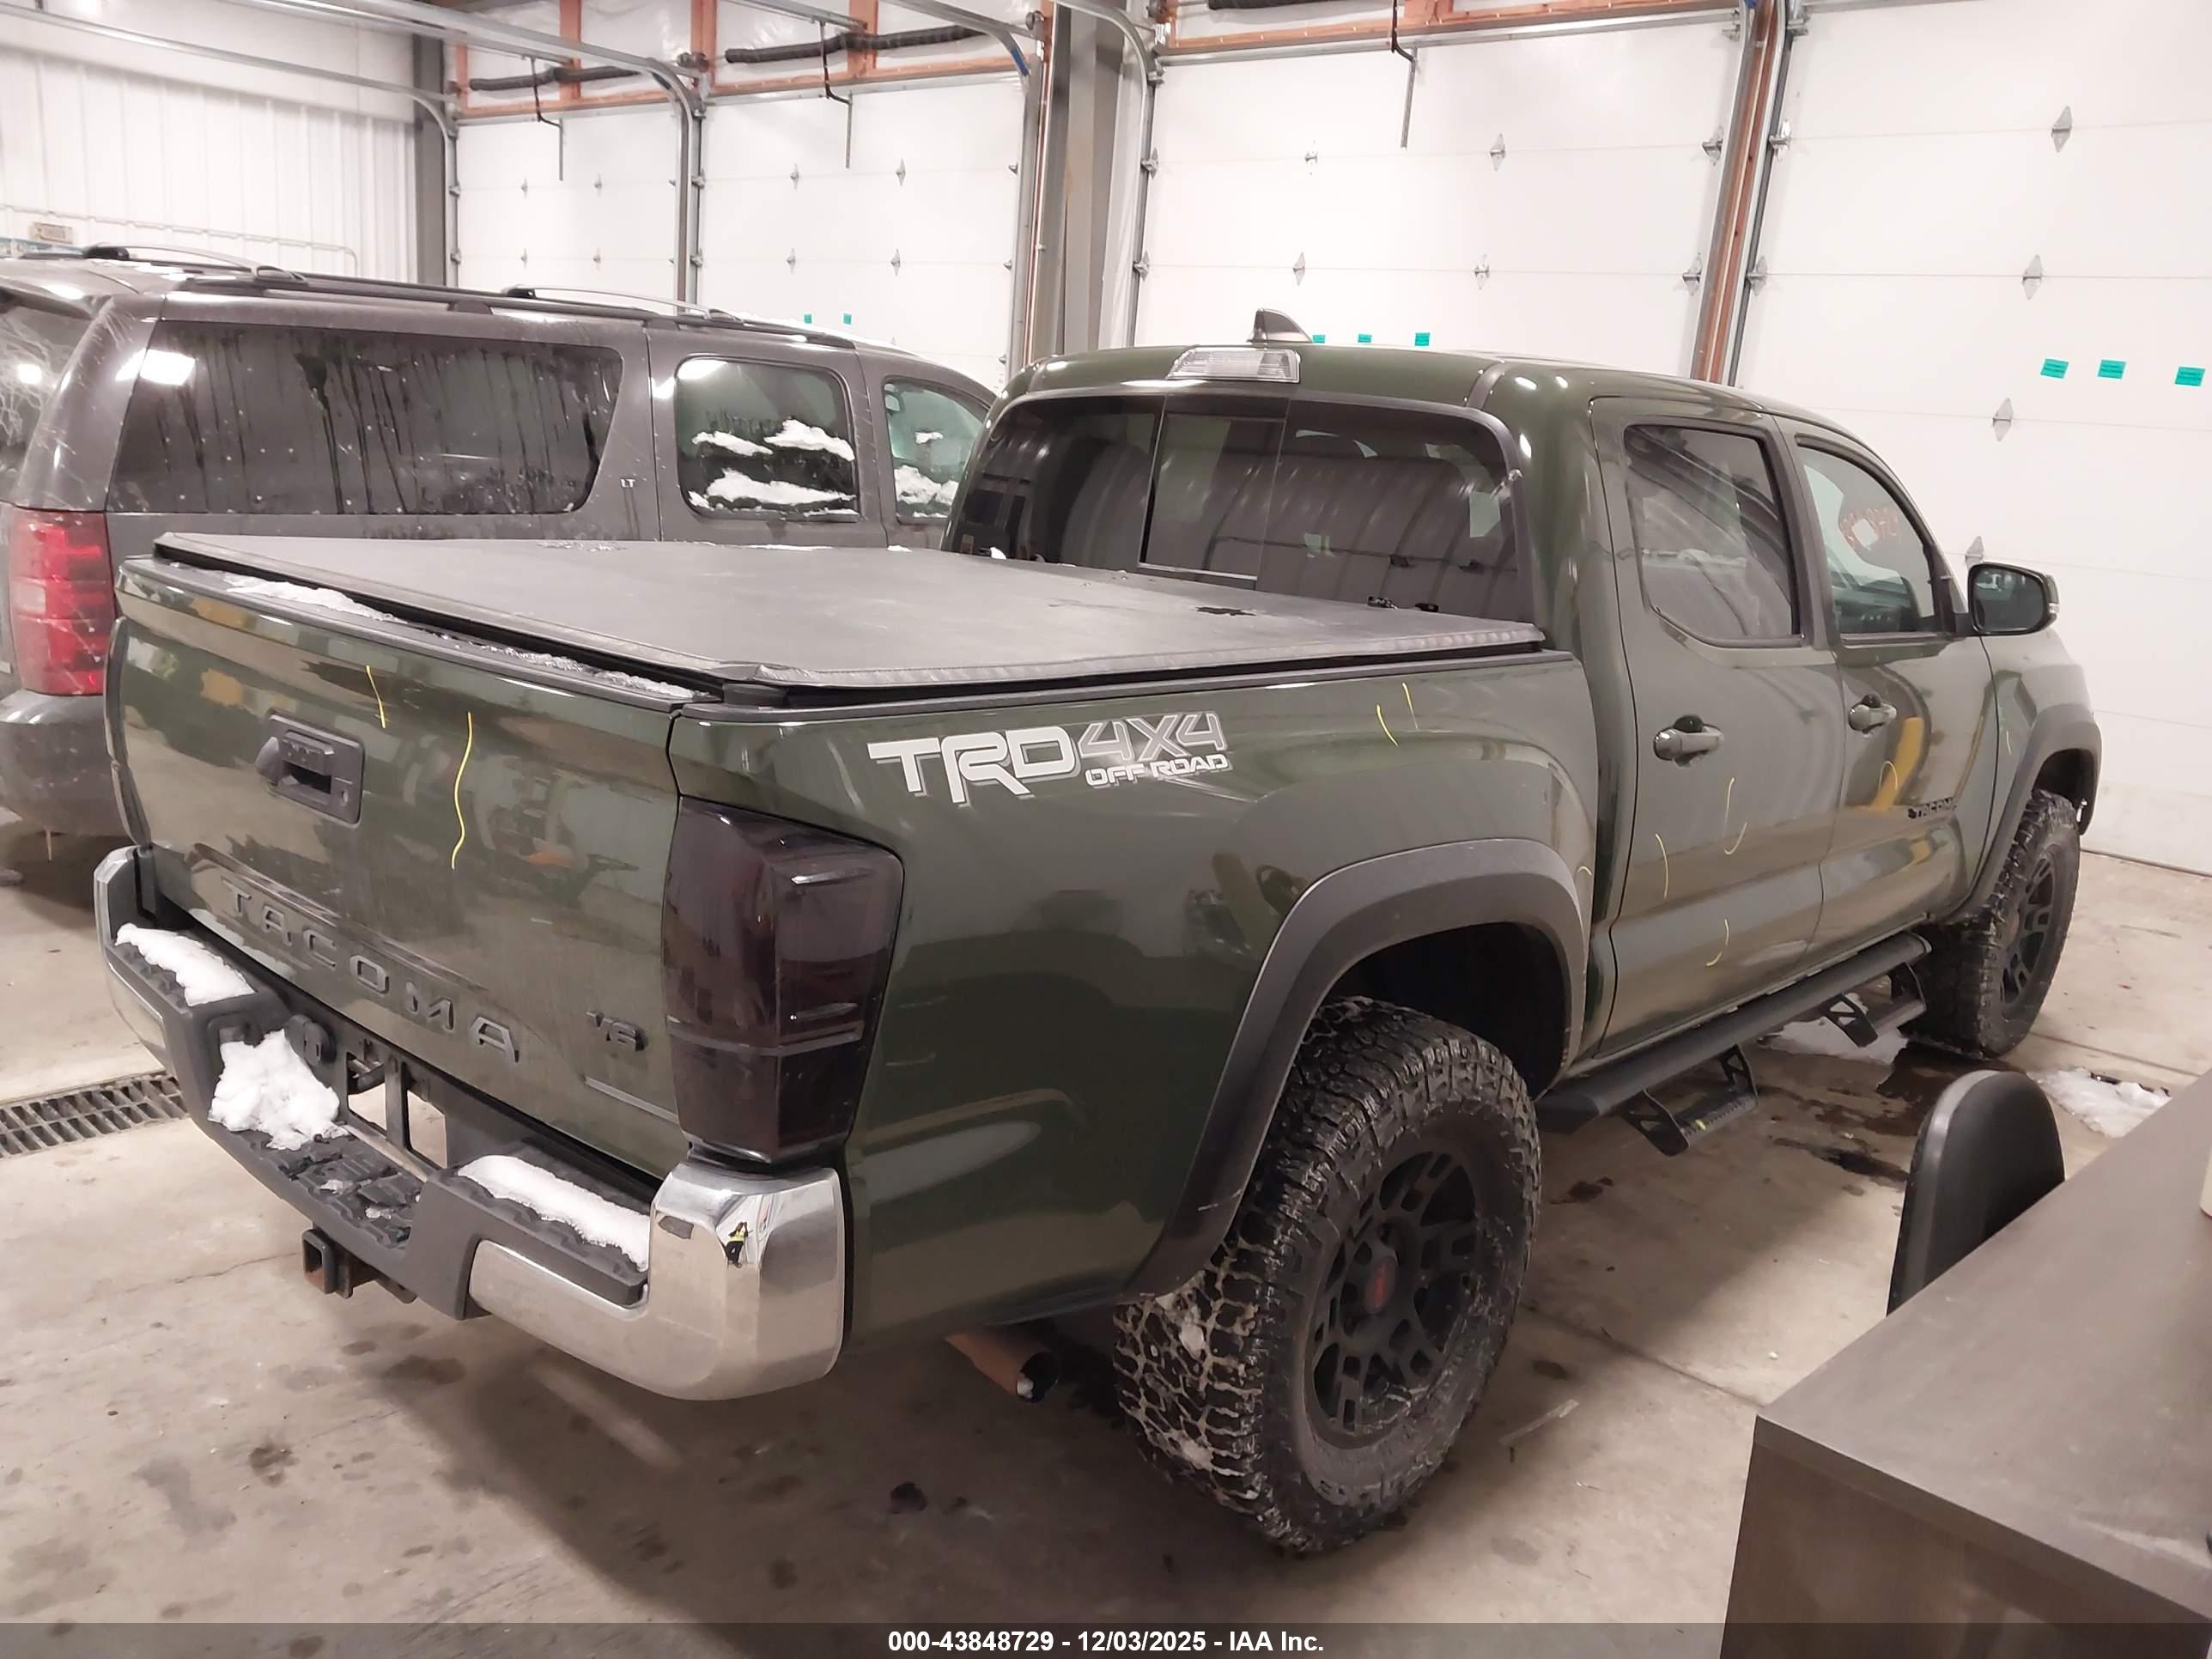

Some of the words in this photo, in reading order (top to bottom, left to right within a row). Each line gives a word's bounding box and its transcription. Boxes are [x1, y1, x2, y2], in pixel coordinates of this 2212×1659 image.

[620, 477, 636, 489] LT
[866, 726, 1079, 808] TRD
[1085, 766, 1147, 789] OFF
[1150, 753, 1234, 779] ROAD
[221, 877, 520, 1063] TACOMA
[586, 1012, 647, 1051] V6
